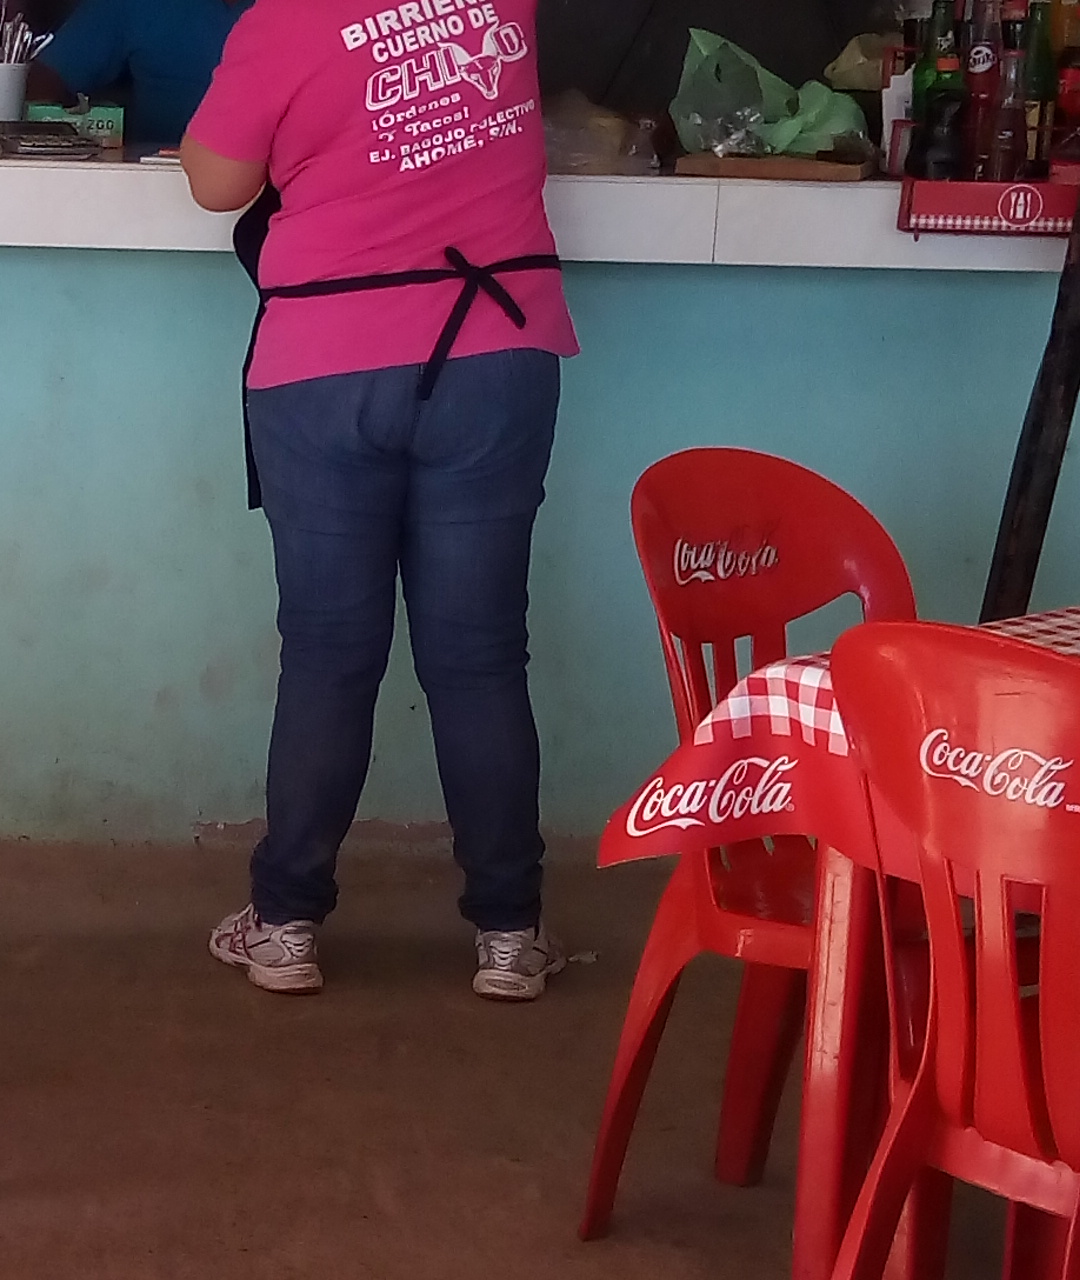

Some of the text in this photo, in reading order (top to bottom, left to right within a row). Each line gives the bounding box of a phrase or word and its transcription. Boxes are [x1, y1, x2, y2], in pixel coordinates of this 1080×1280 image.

[372, 3, 499, 63] CUERNO DE
[626, 754, 800, 837] Coca-Cola
[919, 727, 1074, 809] Coca-Cola
